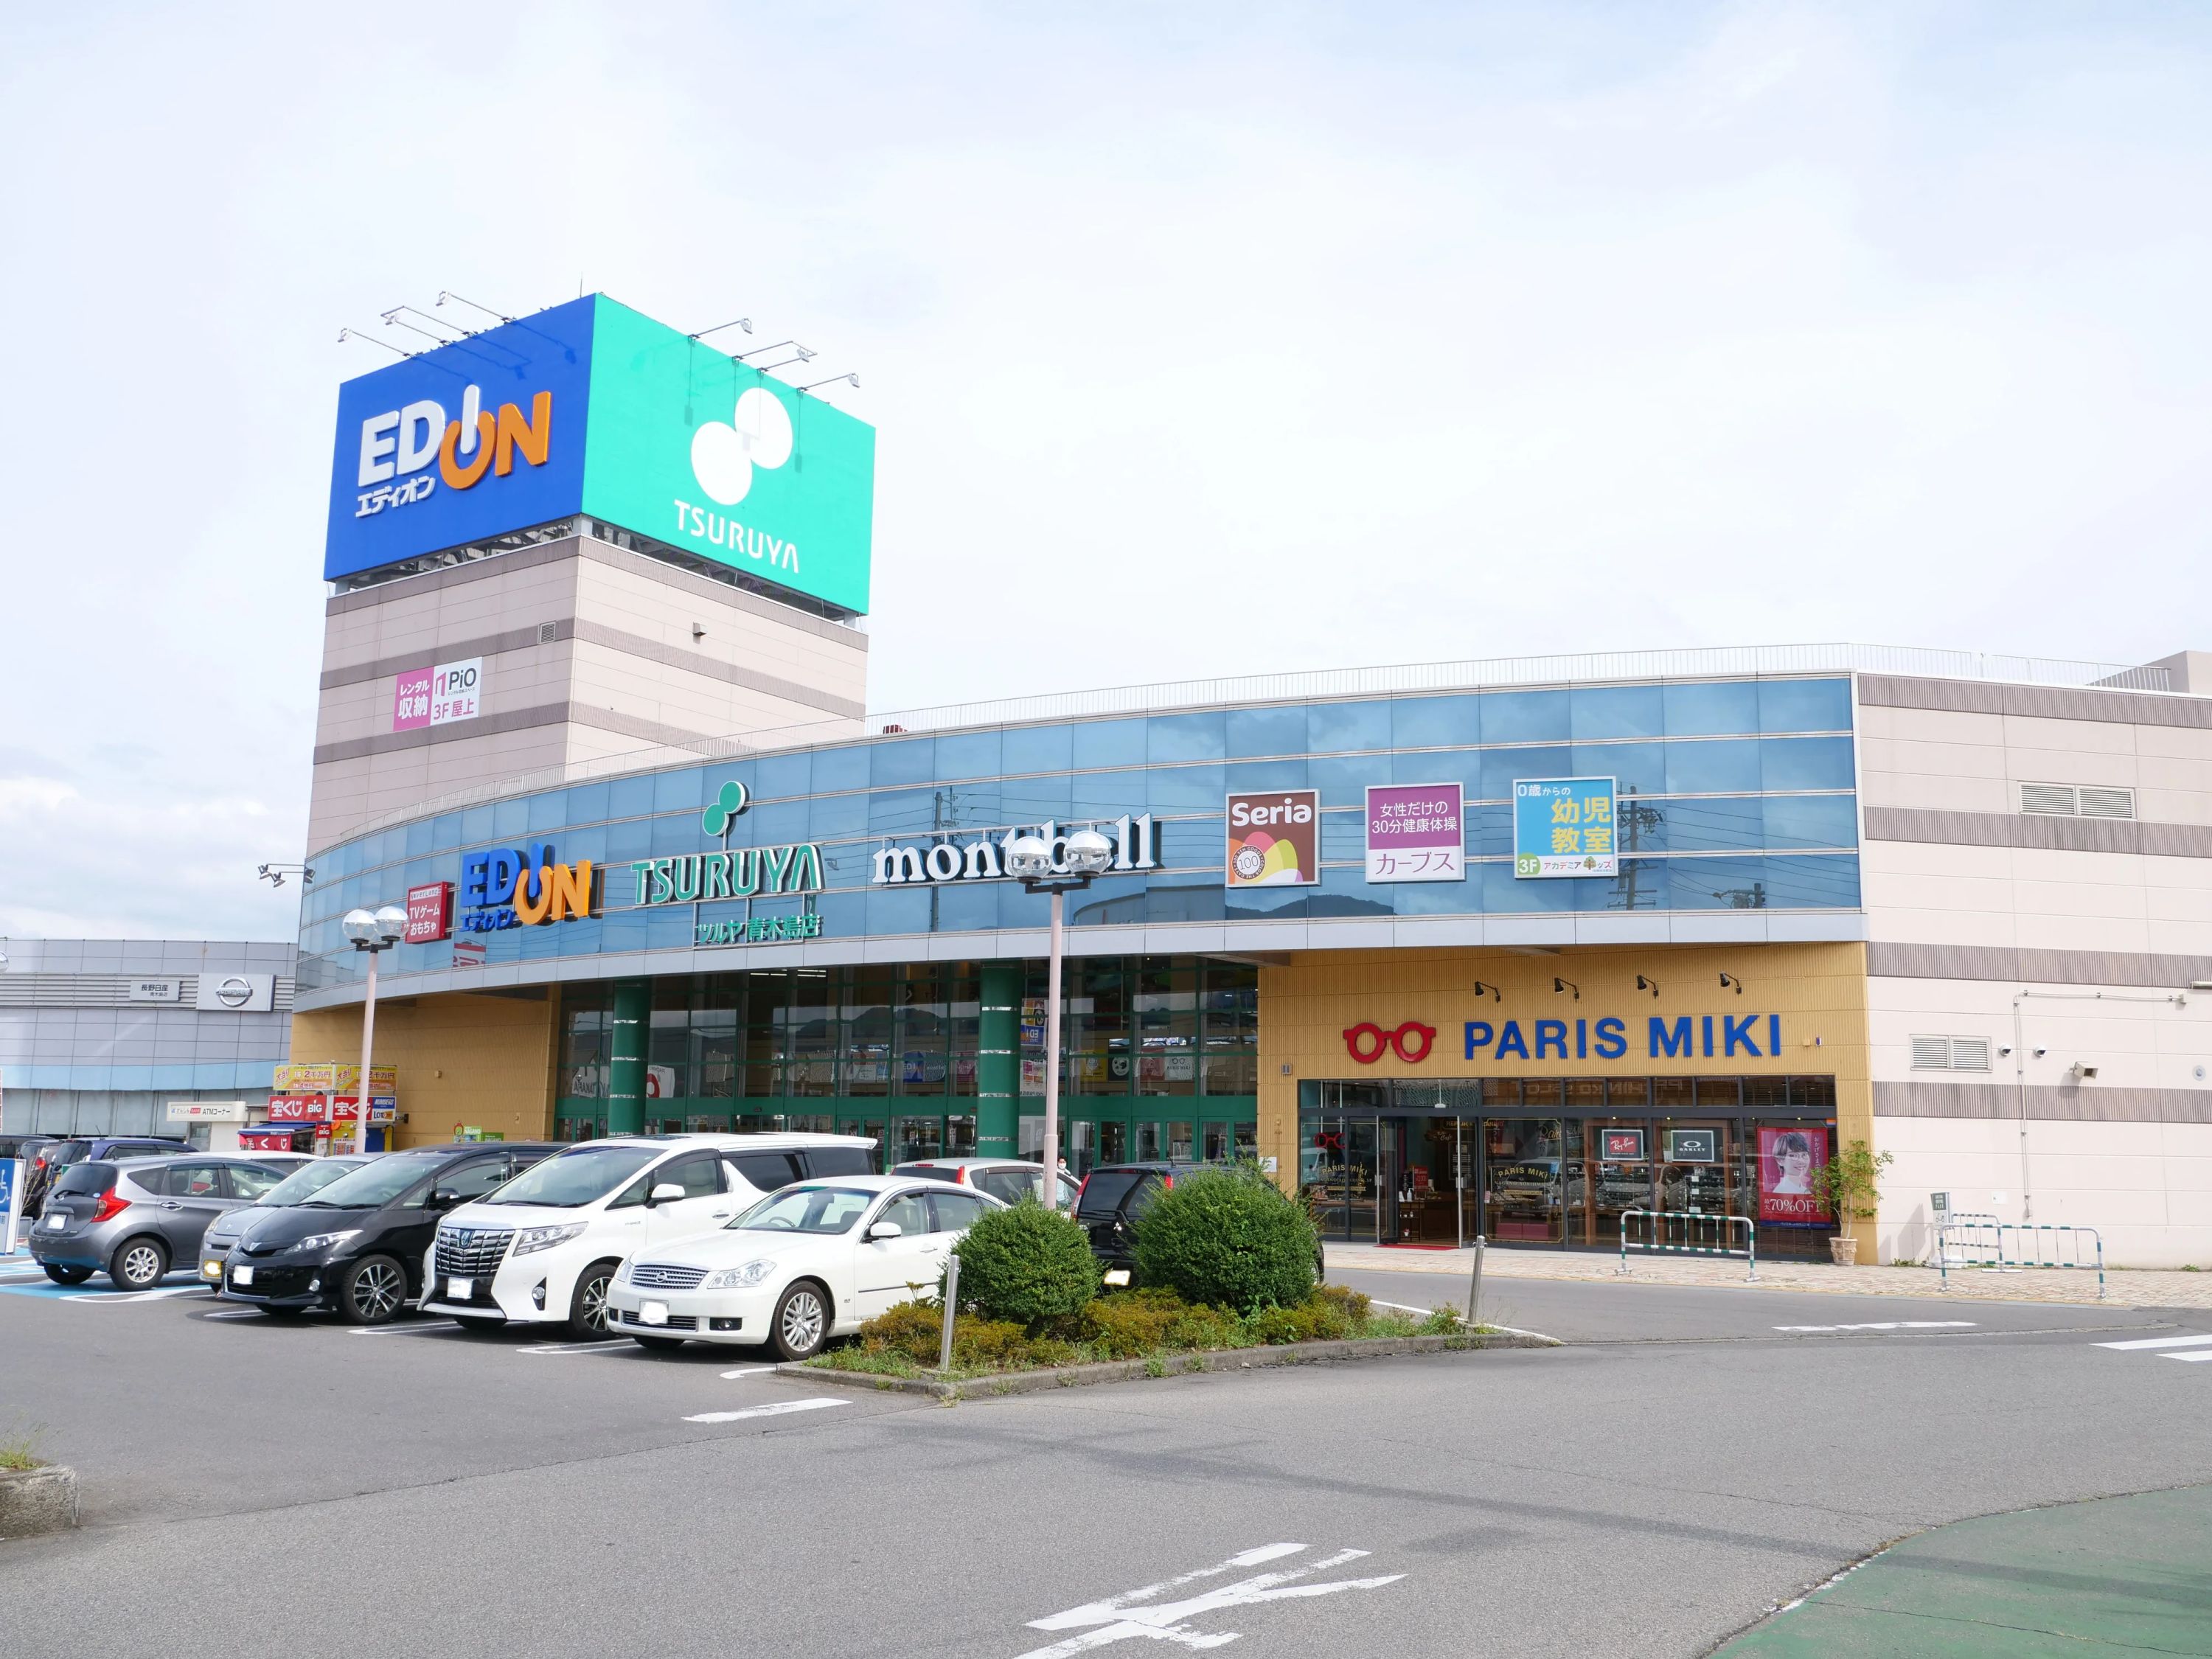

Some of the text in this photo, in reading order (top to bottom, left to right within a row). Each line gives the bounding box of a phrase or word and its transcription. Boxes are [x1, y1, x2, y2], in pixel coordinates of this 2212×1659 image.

[358, 383, 552, 490] EDION
[355, 475, 437, 518] エディオン
[673, 498, 799, 574] TSURUYA
[400, 679, 430, 696] レンタル
[398, 694, 428, 720] 収納
[433, 698, 474, 720] 3F 屋上
[1517, 784, 1571, 797] 0歳からの
[1231, 797, 1312, 827] Seria
[1380, 801, 1449, 818] 女性だけの
[1551, 796, 1612, 824] 幼児
[1371, 816, 1458, 834] 30分健康体操
[872, 812, 1157, 884] montbll
[1551, 826, 1613, 854] 教室
[1238, 855, 1259, 871] 100
[1375, 851, 1455, 875] カーブス
[1518, 858, 1537, 874] 3F
[630, 844, 822, 905] TSURUYA
[460, 843, 592, 925] EDION
[409, 902, 440, 920] TVゲーム
[410, 920, 437, 936] おもちゃ
[1464, 1013, 1782, 1060] PARIS MIKI
[202, 1107, 231, 1116] ATMコーナー
[271, 1099, 302, 1117] 宝くじ
[307, 1099, 323, 1113] BIG
[318, 1127, 330, 1135] BIG
[1321, 1164, 1368, 1176] PARIS MIKI
[1498, 1166, 1548, 1180] PARIS MIKI
